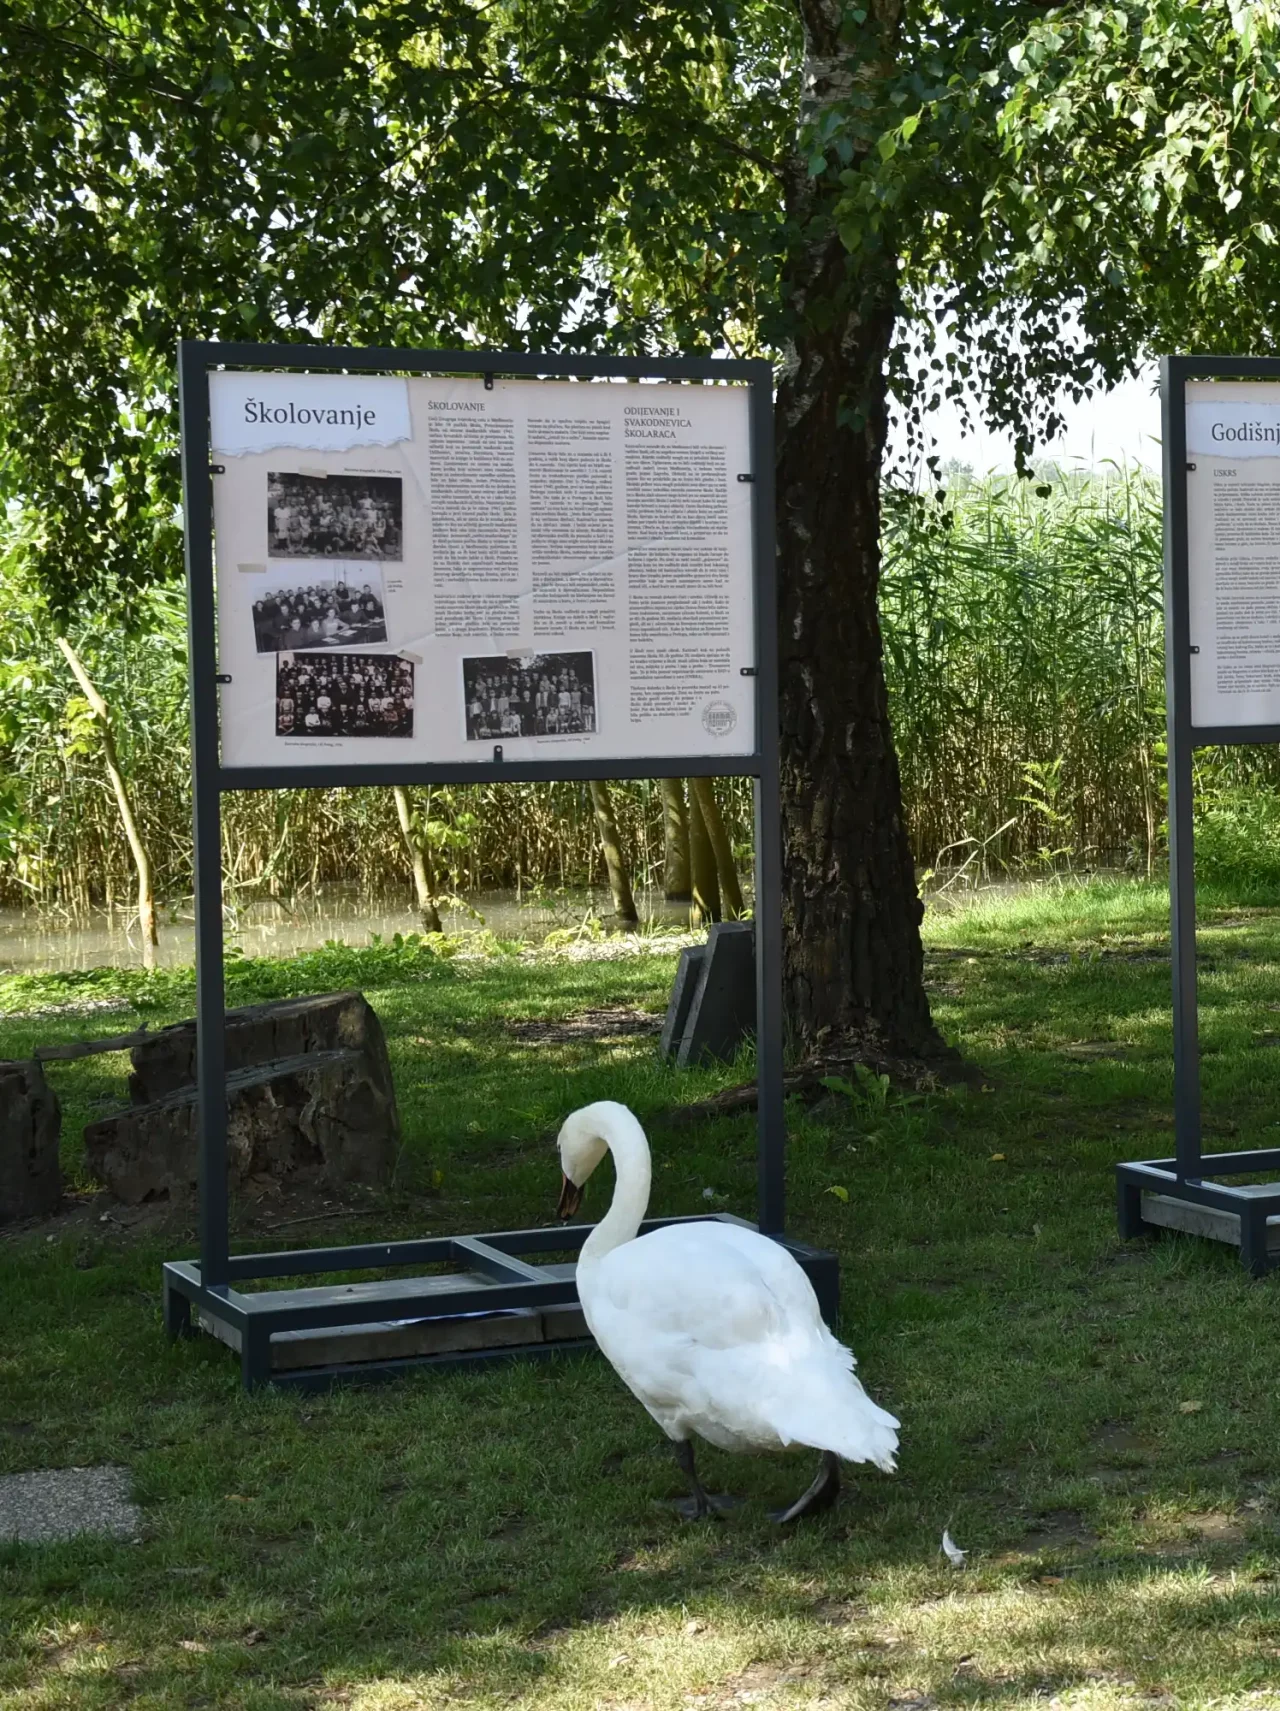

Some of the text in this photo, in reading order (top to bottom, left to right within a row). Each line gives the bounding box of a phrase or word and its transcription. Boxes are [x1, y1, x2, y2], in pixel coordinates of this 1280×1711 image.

[427, 400, 486, 411] ŠKOLOVANJE
[244, 397, 376, 430] Školovanje
[623, 406, 675, 417] ODIJEVANJE
[624, 418, 692, 428] SVAKODNEVICA
[624, 428, 676, 439] ŠKOLARACA
[1213, 468, 1237, 477] USKRS
